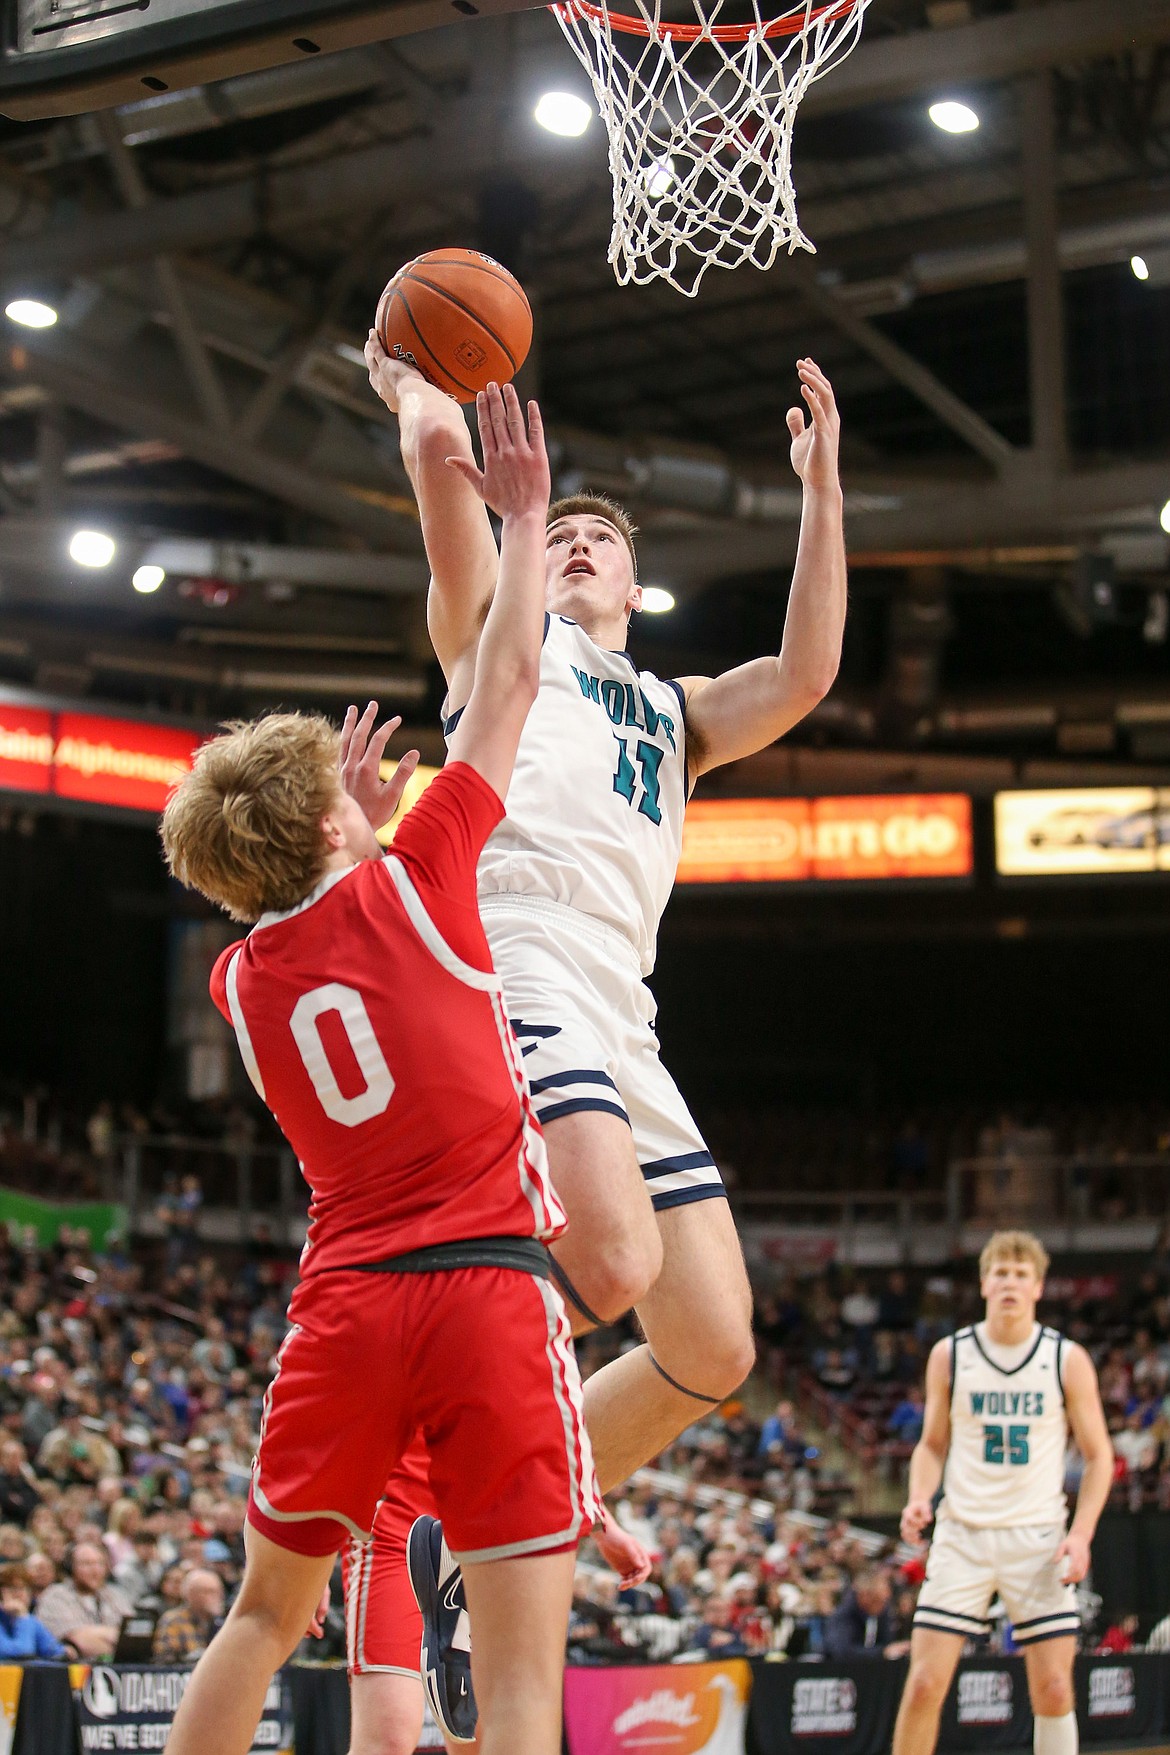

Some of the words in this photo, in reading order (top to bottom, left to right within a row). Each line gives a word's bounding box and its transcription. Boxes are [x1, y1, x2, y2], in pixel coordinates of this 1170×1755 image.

[612, 730, 664, 826] 11
[289, 982, 396, 1128] 0
[969, 1391, 1044, 1416] WOLVES
[983, 1425, 1030, 1465] 25
